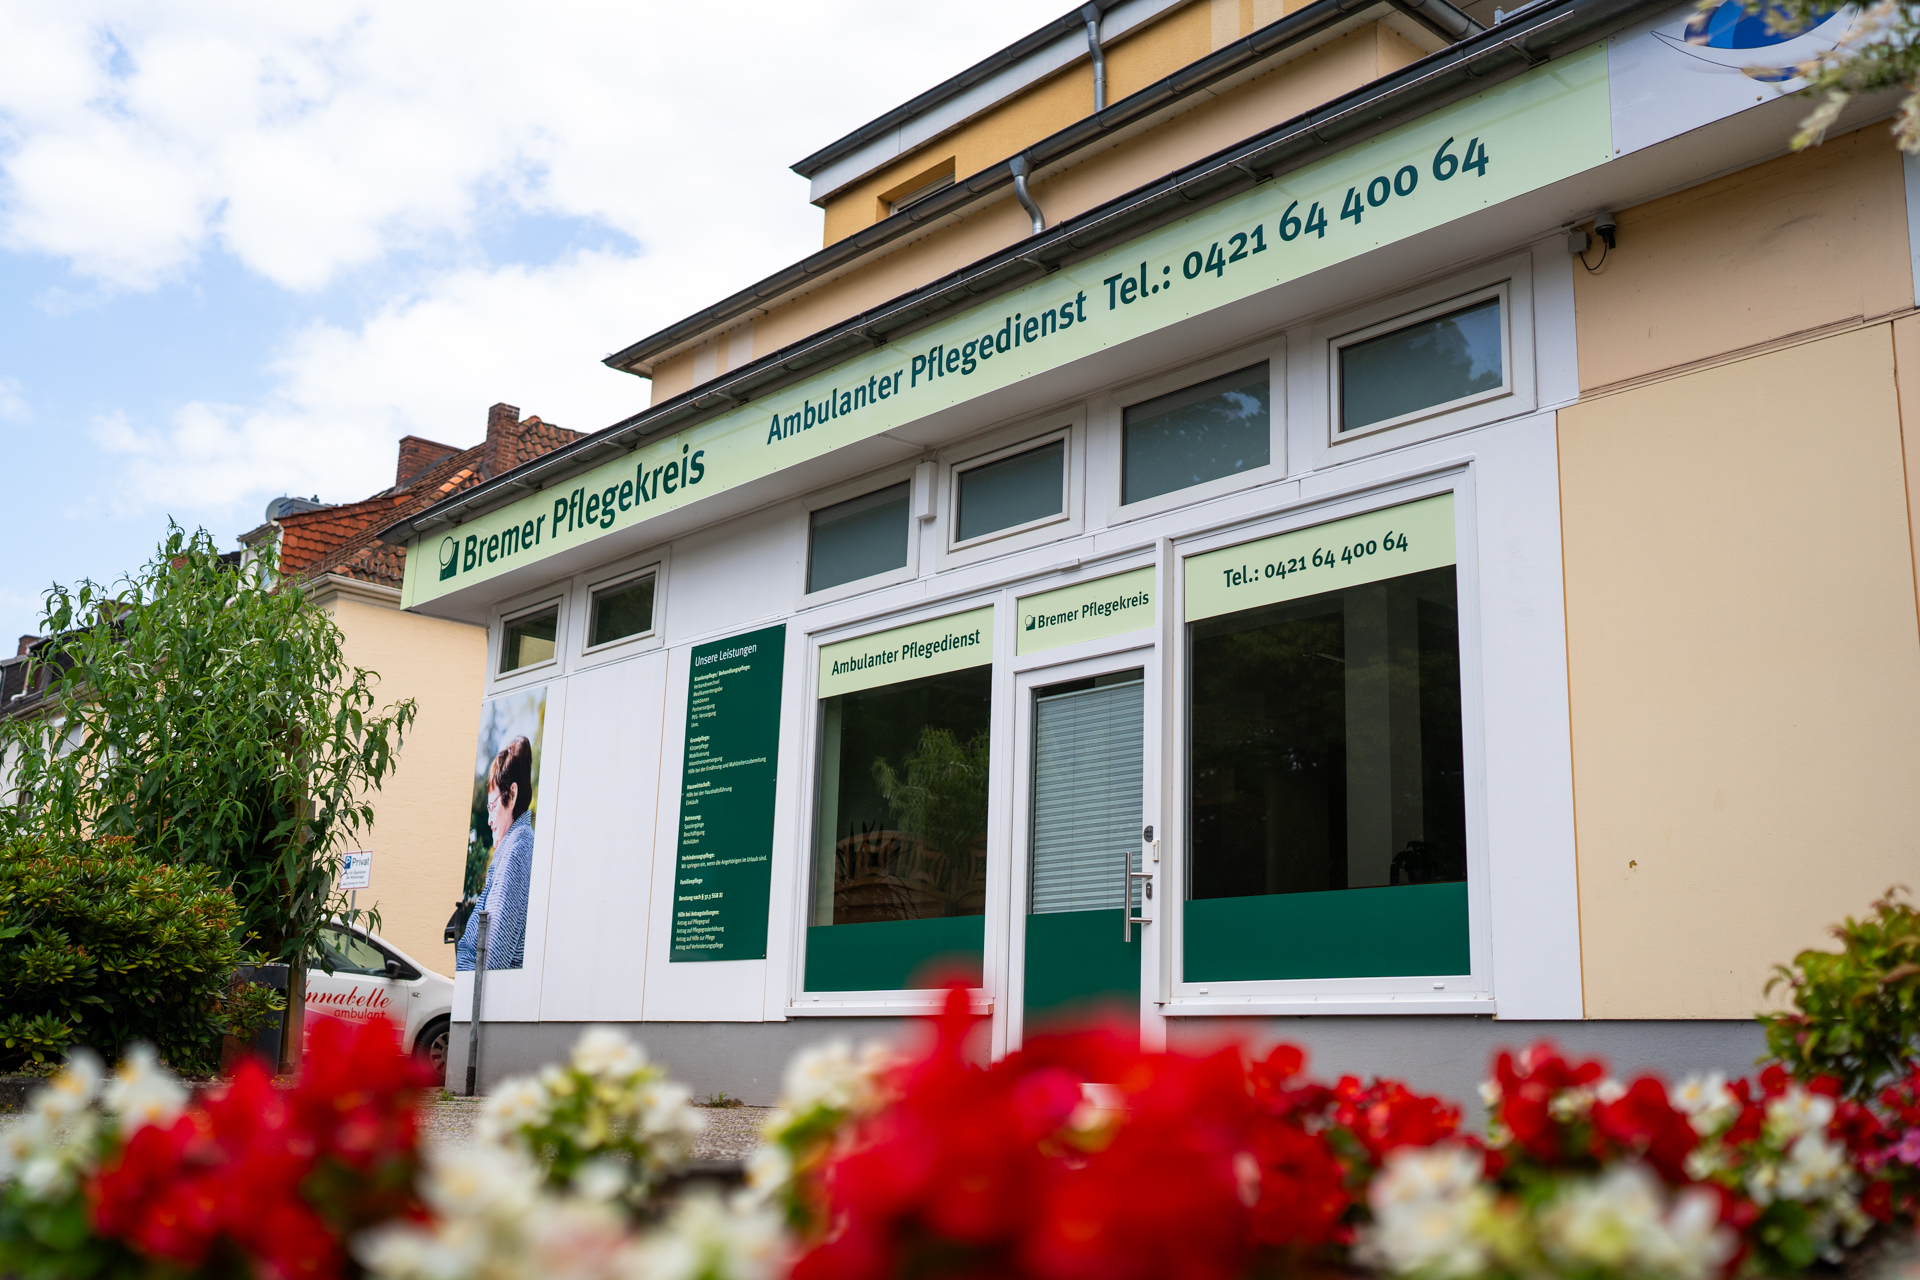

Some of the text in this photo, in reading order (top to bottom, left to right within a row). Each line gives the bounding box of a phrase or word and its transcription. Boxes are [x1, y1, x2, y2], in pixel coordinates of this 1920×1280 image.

[767, 137, 1489, 445] Ambulanter Pflegedienst Tel.: 0421 64 400 64
[463, 444, 704, 572] Bremer Pflegekreis
[1224, 531, 1408, 587] Tel.: 0421 64 400 64
[1039, 592, 1148, 628] Bremer Pflegekreis
[695, 644, 757, 666] Unsere Leistungen
[832, 630, 980, 675] Ambulanter Pflegedienst
[352, 857, 369, 866] Privat
[334, 1007, 385, 1020] ambulant
